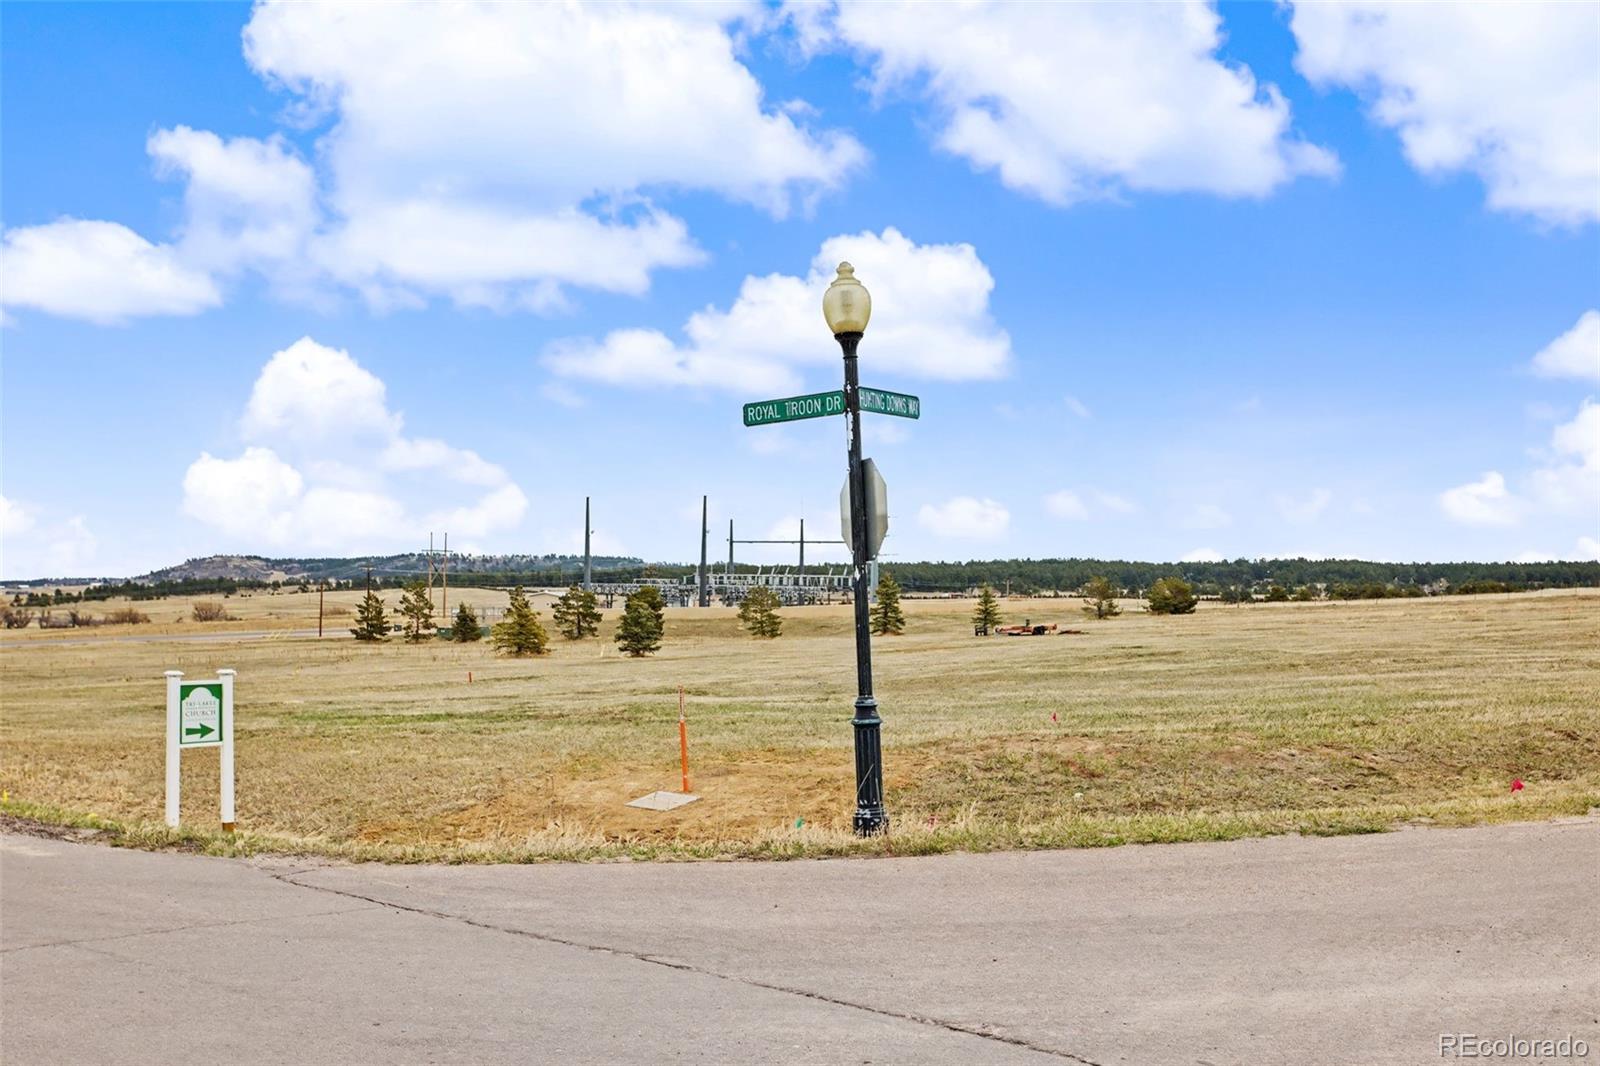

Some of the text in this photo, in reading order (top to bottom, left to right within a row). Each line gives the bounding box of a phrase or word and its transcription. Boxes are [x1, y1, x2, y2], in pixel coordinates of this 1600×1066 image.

[747, 395, 841, 421] ROYAL TROON DR
[886, 395, 907, 413] DOWNS
[185, 709, 216, 718] CHURCH
